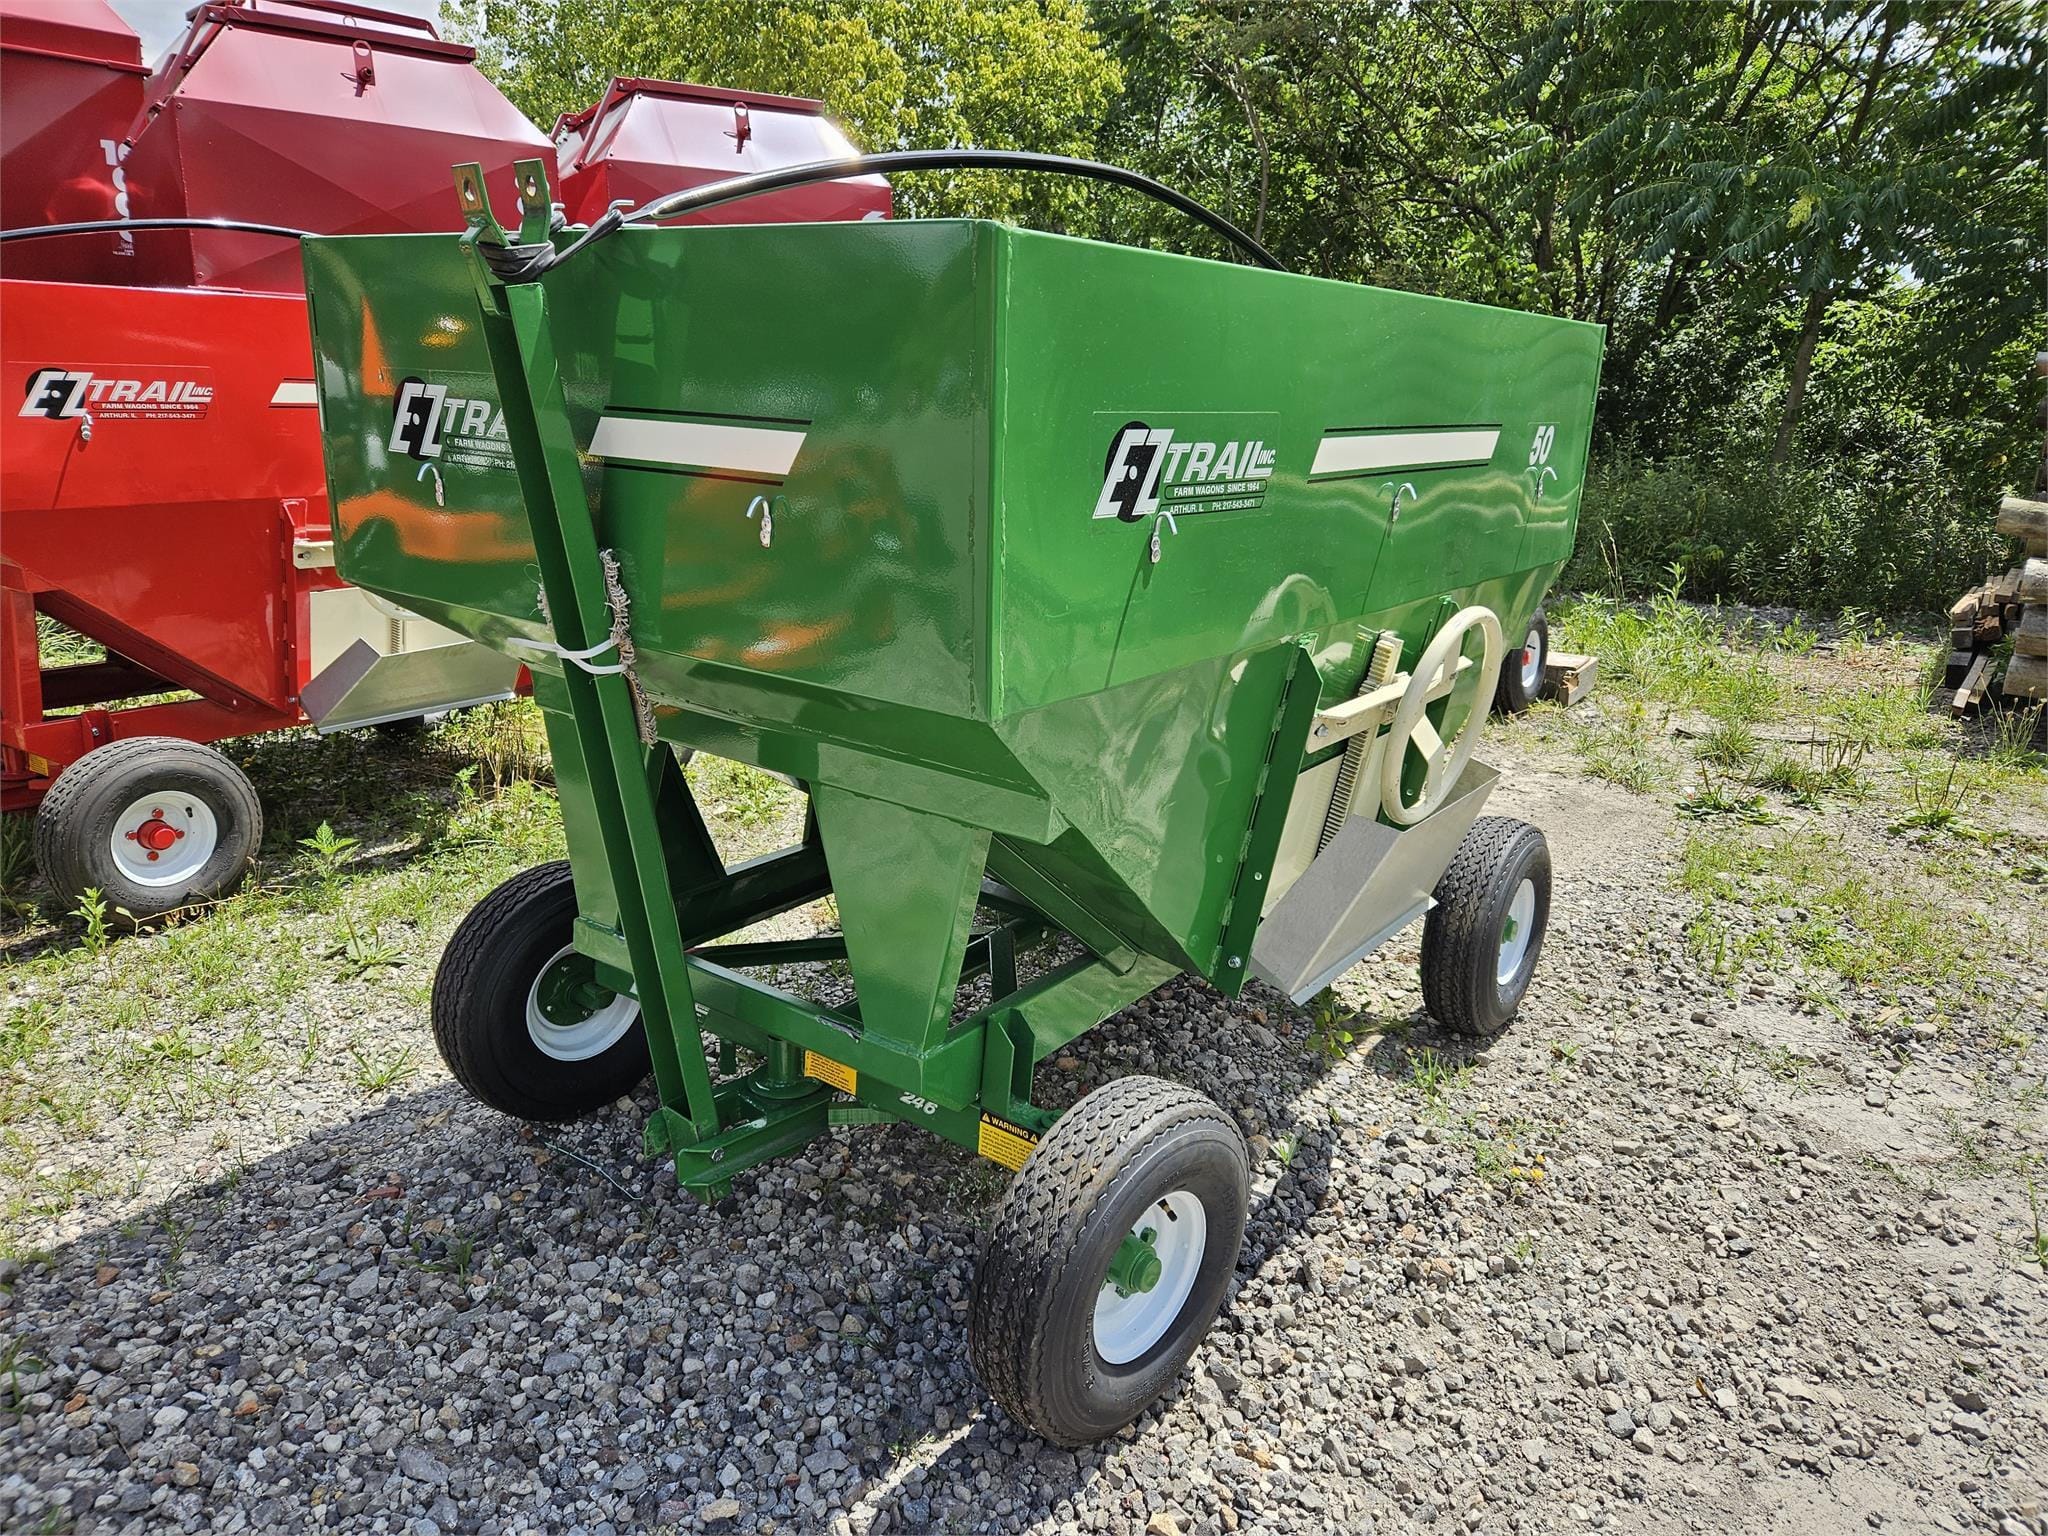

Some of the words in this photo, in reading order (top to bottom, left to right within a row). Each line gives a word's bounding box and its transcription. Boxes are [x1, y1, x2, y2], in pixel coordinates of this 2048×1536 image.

[18, 371, 94, 417] EZ
[89, 379, 213, 403] TRAIL
[191, 386, 214, 396] INC.
[388, 382, 447, 457] EZ
[443, 398, 510, 439] TRA
[454, 438, 475, 448] FARM
[1529, 425, 1555, 466] 50
[1092, 428, 1175, 519] EZ
[1163, 441, 1273, 483] TRAIL
[1256, 449, 1276, 465] INC.
[1173, 486, 1194, 497] FARM
[1195, 484, 1225, 496] WAGONS
[1227, 482, 1246, 493] SINCE
[1211, 501, 1221, 511] PH:
[899, 1091, 938, 1115] 246
[991, 1116, 1029, 1139] WARNING
